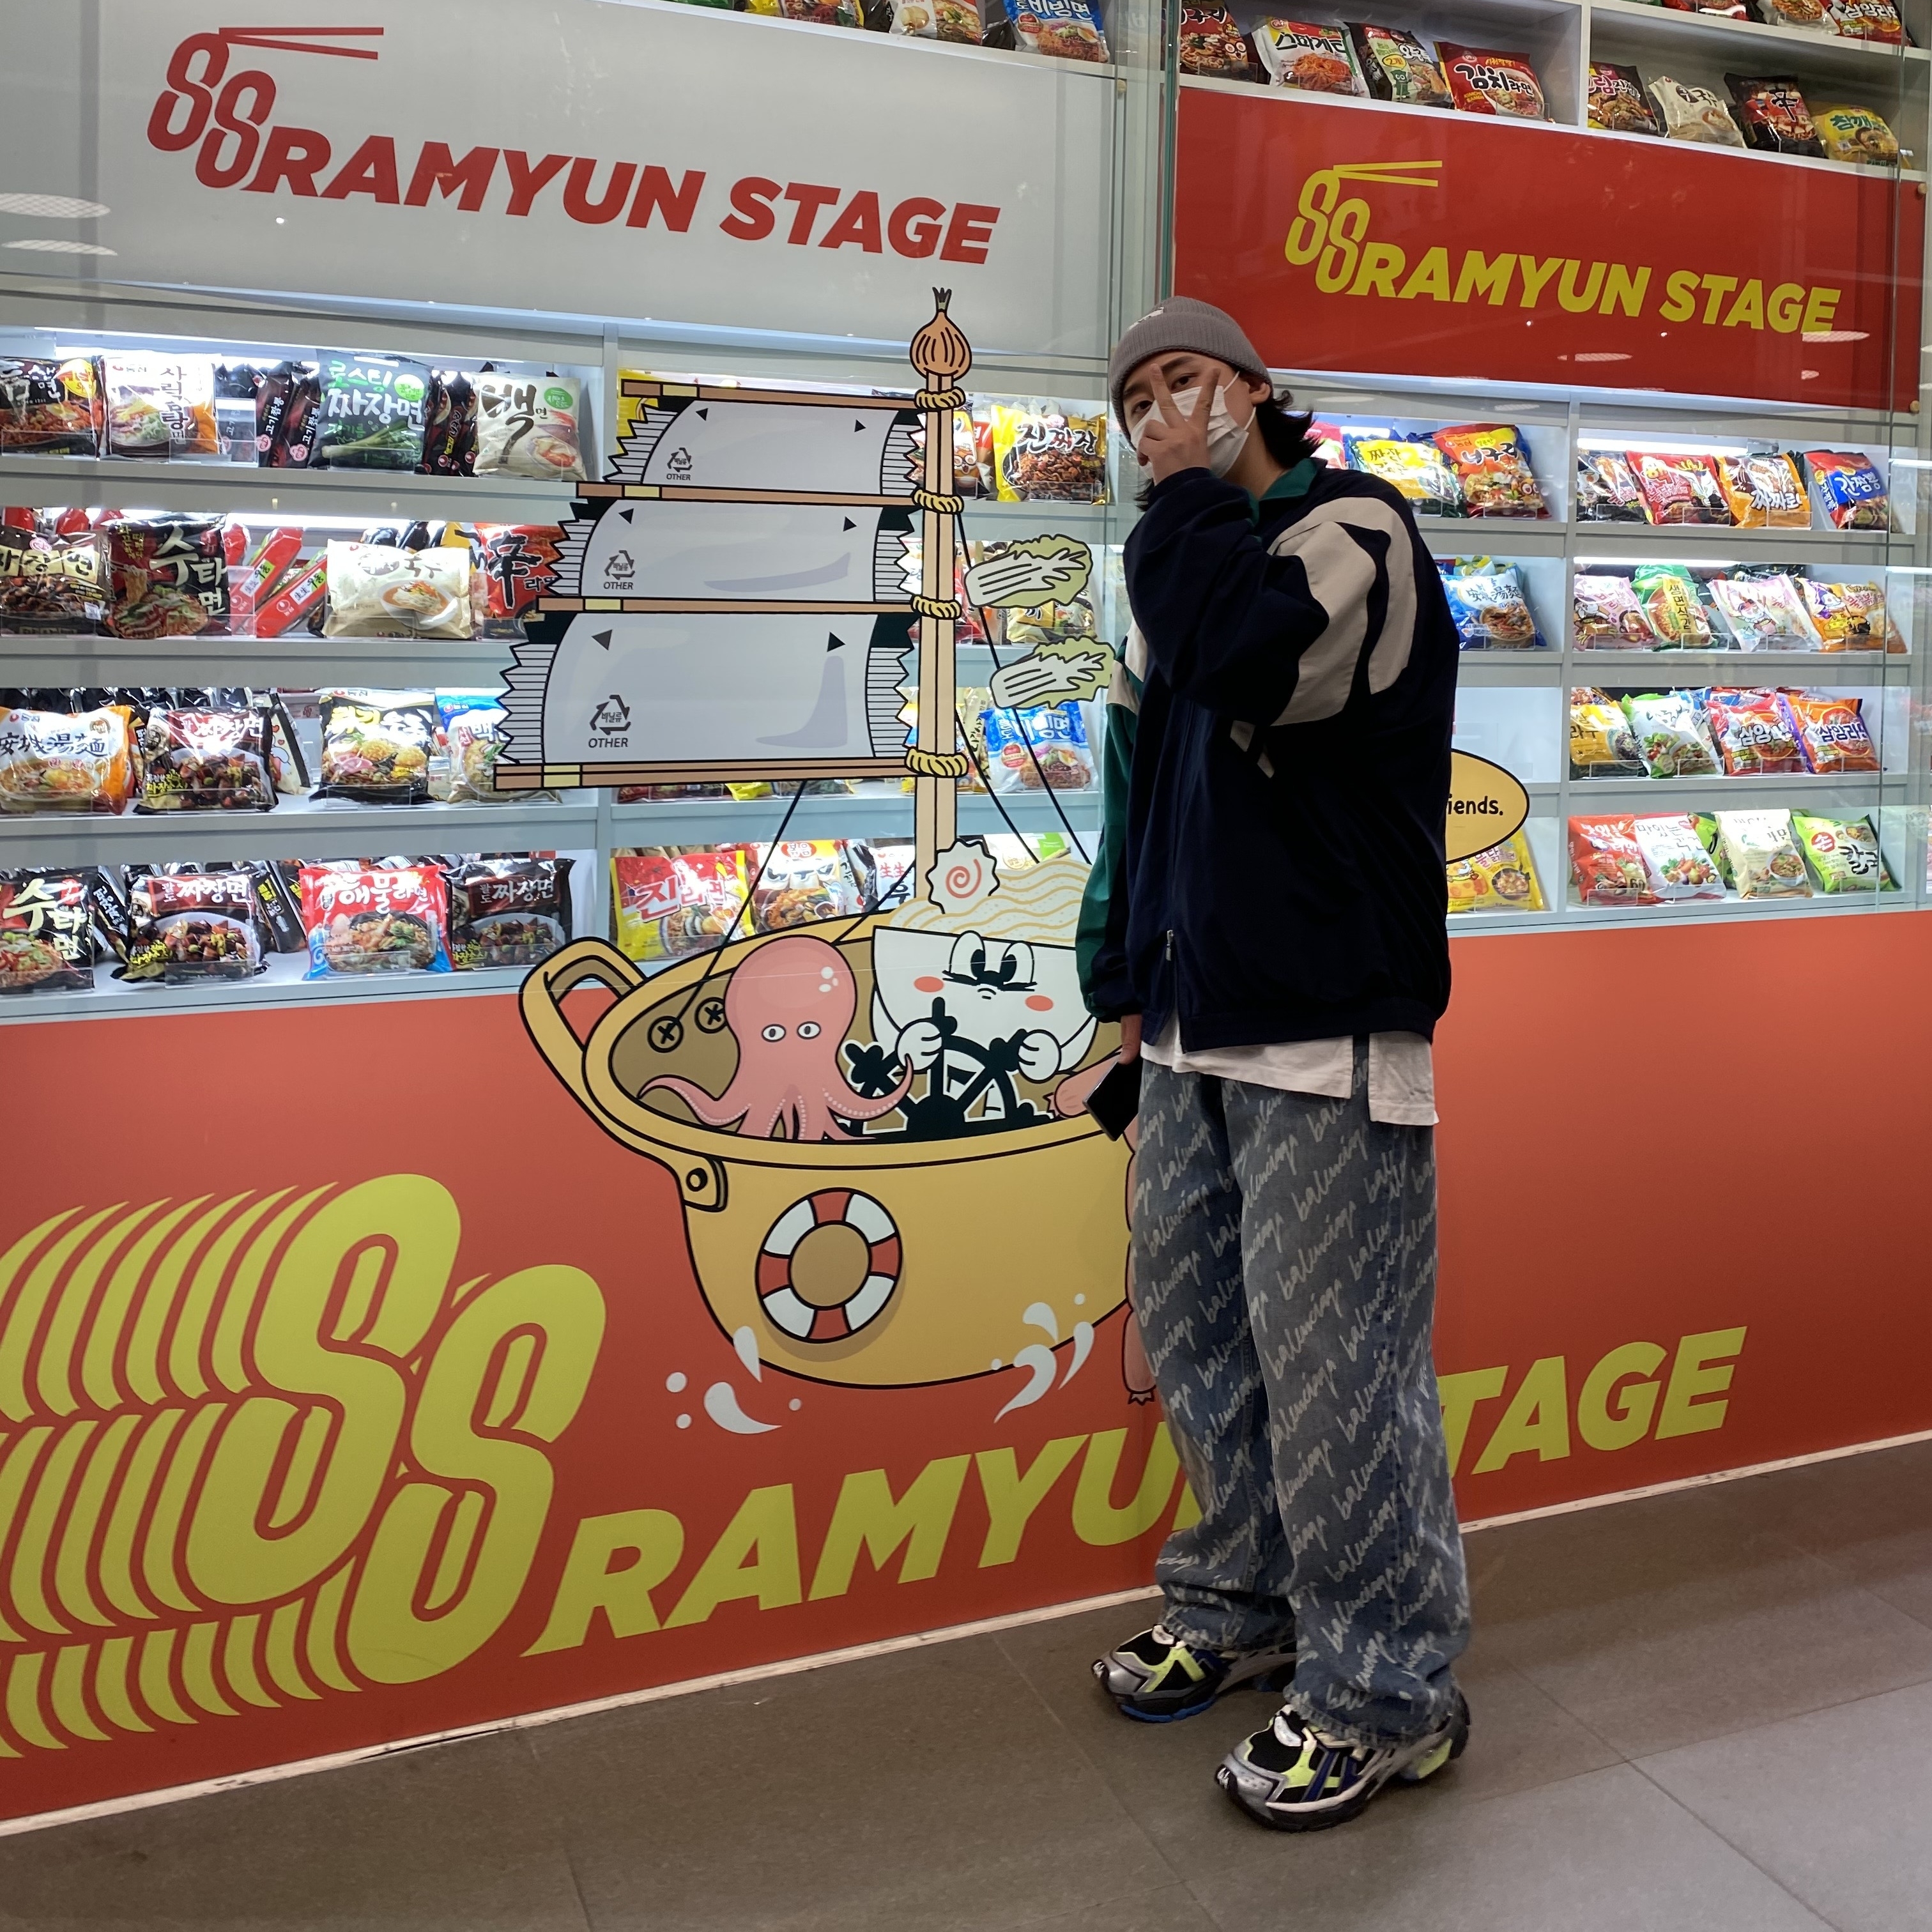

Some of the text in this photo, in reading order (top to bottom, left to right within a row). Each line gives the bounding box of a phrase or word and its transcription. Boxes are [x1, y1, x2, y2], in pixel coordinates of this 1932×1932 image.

[1181, 6, 1227, 24] 구리
[1454, 63, 1535, 96] 김치라면
[1768, 86, 1799, 122] 辛
[240, 126, 707, 233] RAMYUN
[719, 176, 1001, 264] STAGE
[1344, 241, 1652, 317] RAMYUN
[1659, 270, 1841, 335] STAGE
[327, 360, 393, 393] 로스팅
[327, 388, 425, 431] 짜장면
[1013, 419, 1098, 456] 진짜장
[1460, 442, 1519, 464] 너구리
[666, 473, 691, 481] OTHER
[1834, 471, 1881, 496] 간짬뽕
[149, 524, 227, 616] 수타면
[487, 530, 542, 609] 辛
[603, 581, 634, 590] OTHER
[1669, 584, 1692, 630] 생면식감
[601, 712, 622, 723] 비닐류
[588, 737, 629, 749] OTHER
[1448, 793, 1504, 816] iends.
[879, 861, 903, 878] 生生
[177, 874, 252, 903] 짜장면
[492, 877, 554, 905] 짜장면
[3, 878, 88, 960] 수타면
[1435, 1325, 1748, 1480] TAGE
